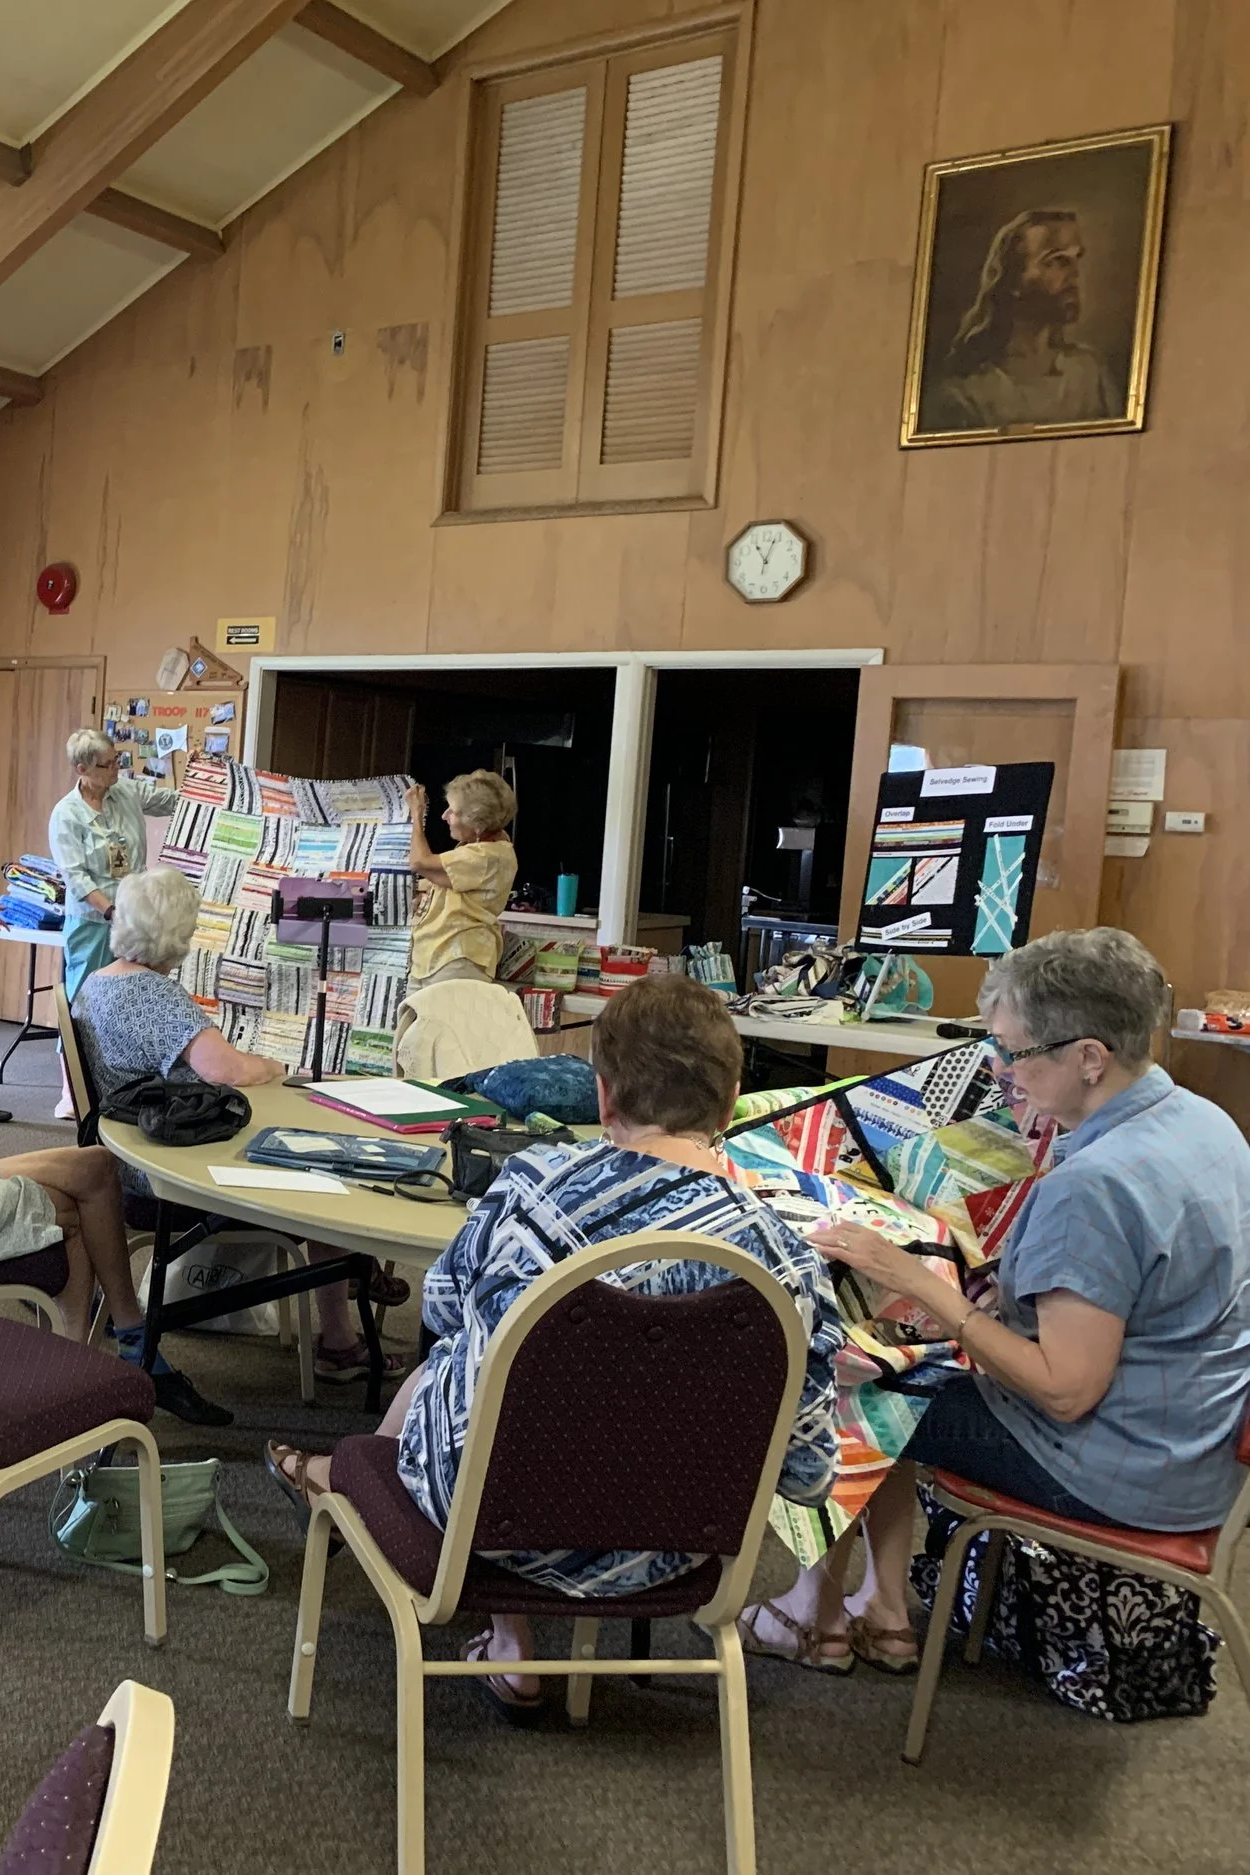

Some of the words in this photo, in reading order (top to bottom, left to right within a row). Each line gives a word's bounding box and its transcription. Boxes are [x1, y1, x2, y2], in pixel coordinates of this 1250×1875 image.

[153, 706, 187, 717] TROOP
[195, 708, 210, 718] 117
[930, 778, 961, 786] Selvedge
[885, 810, 910, 818] Overlap
[1006, 820, 1029, 828] Under
[885, 927, 900, 936] Side
[911, 918, 927, 927] Side
